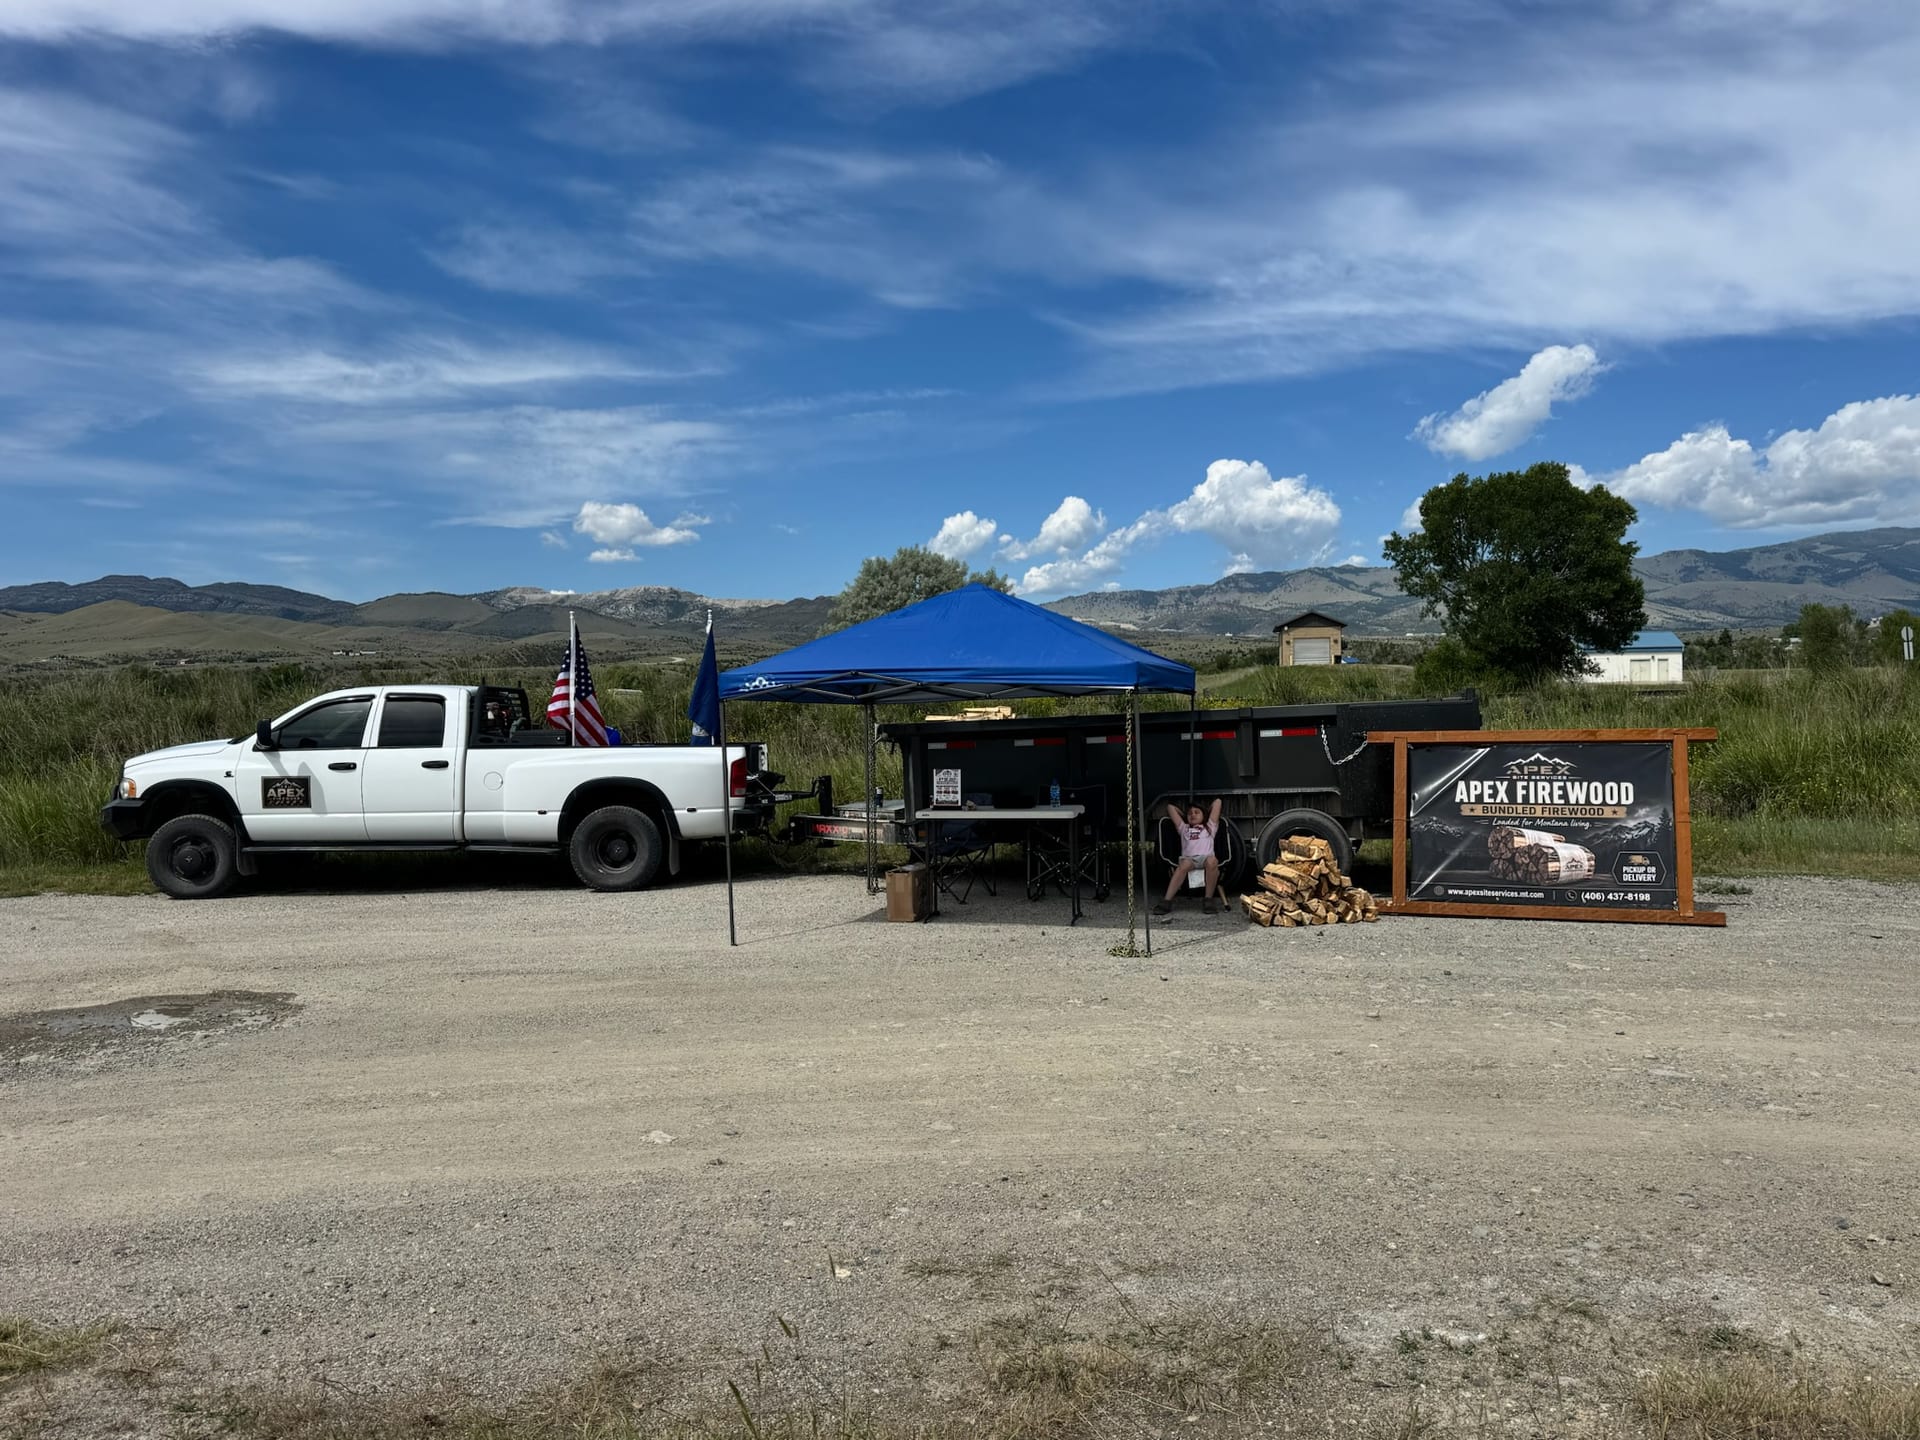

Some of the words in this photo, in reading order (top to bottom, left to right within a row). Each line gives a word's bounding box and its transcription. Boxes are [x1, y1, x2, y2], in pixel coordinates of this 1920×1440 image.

[1506, 765, 1571, 775] APEX
[267, 788, 305, 797] APEX
[1455, 780, 1509, 803] APEX
[1516, 781, 1634, 805] FIREWOOD
[1482, 805, 1537, 815] BUNDLED
[1541, 807, 1604, 816] FIREWOOD
[1492, 817, 1519, 826] Loaded
[1521, 818, 1533, 827] for
[1534, 819, 1569, 828] Montana
[1622, 873, 1656, 882] DELIVERY
[1581, 891, 1605, 902] (406)
[1607, 892, 1651, 901] 437-8198
